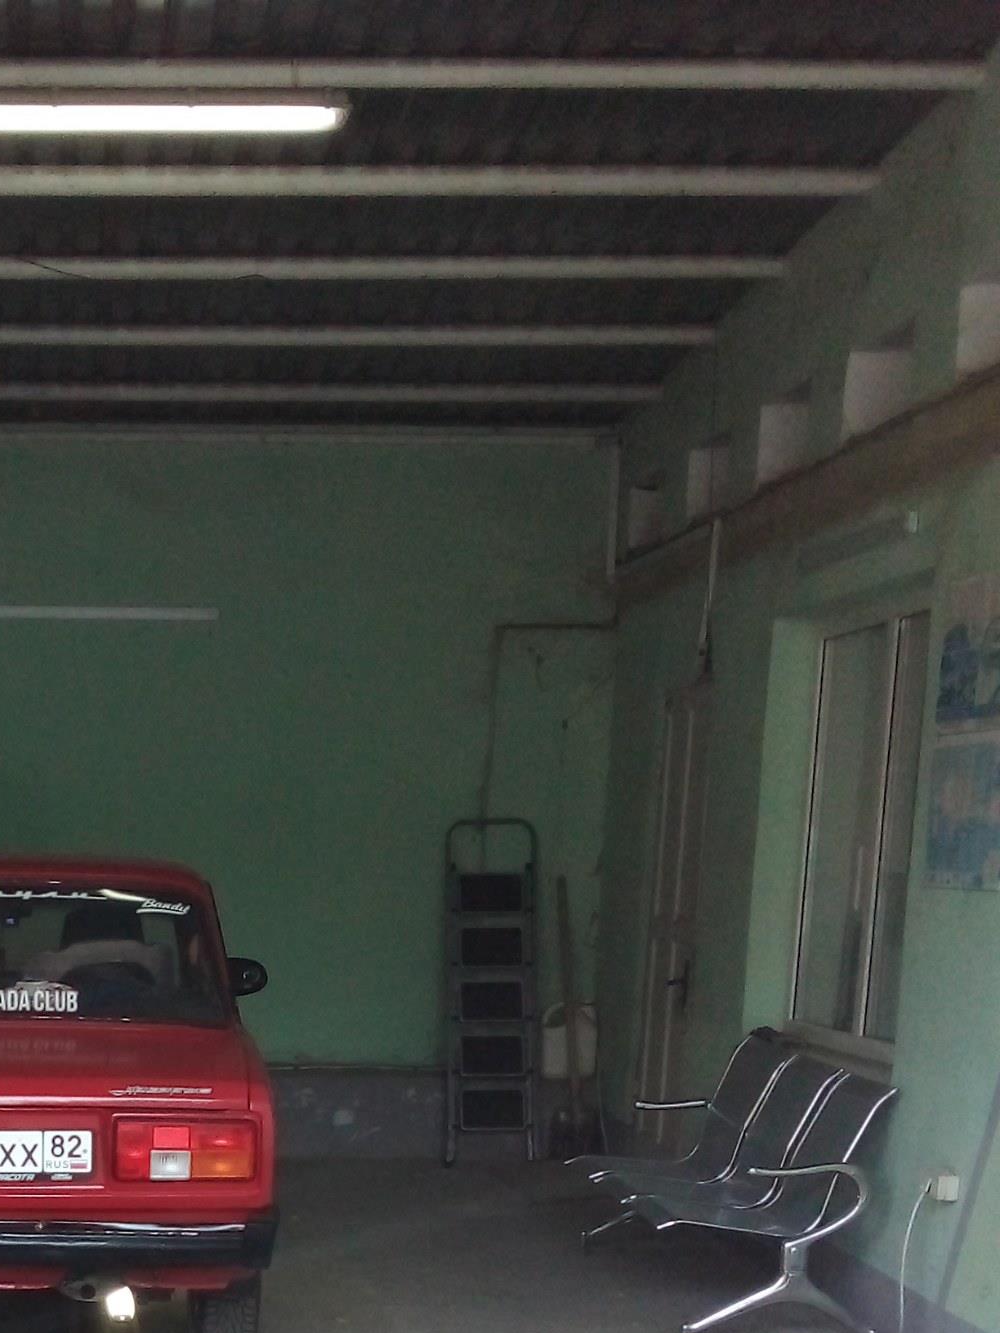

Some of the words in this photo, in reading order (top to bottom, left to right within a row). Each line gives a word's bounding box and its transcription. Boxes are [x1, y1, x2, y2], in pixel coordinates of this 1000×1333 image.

[33, 989, 79, 1012] CLUB
[51, 1135, 82, 1158] 82
[45, 1160, 69, 1169] RUS
